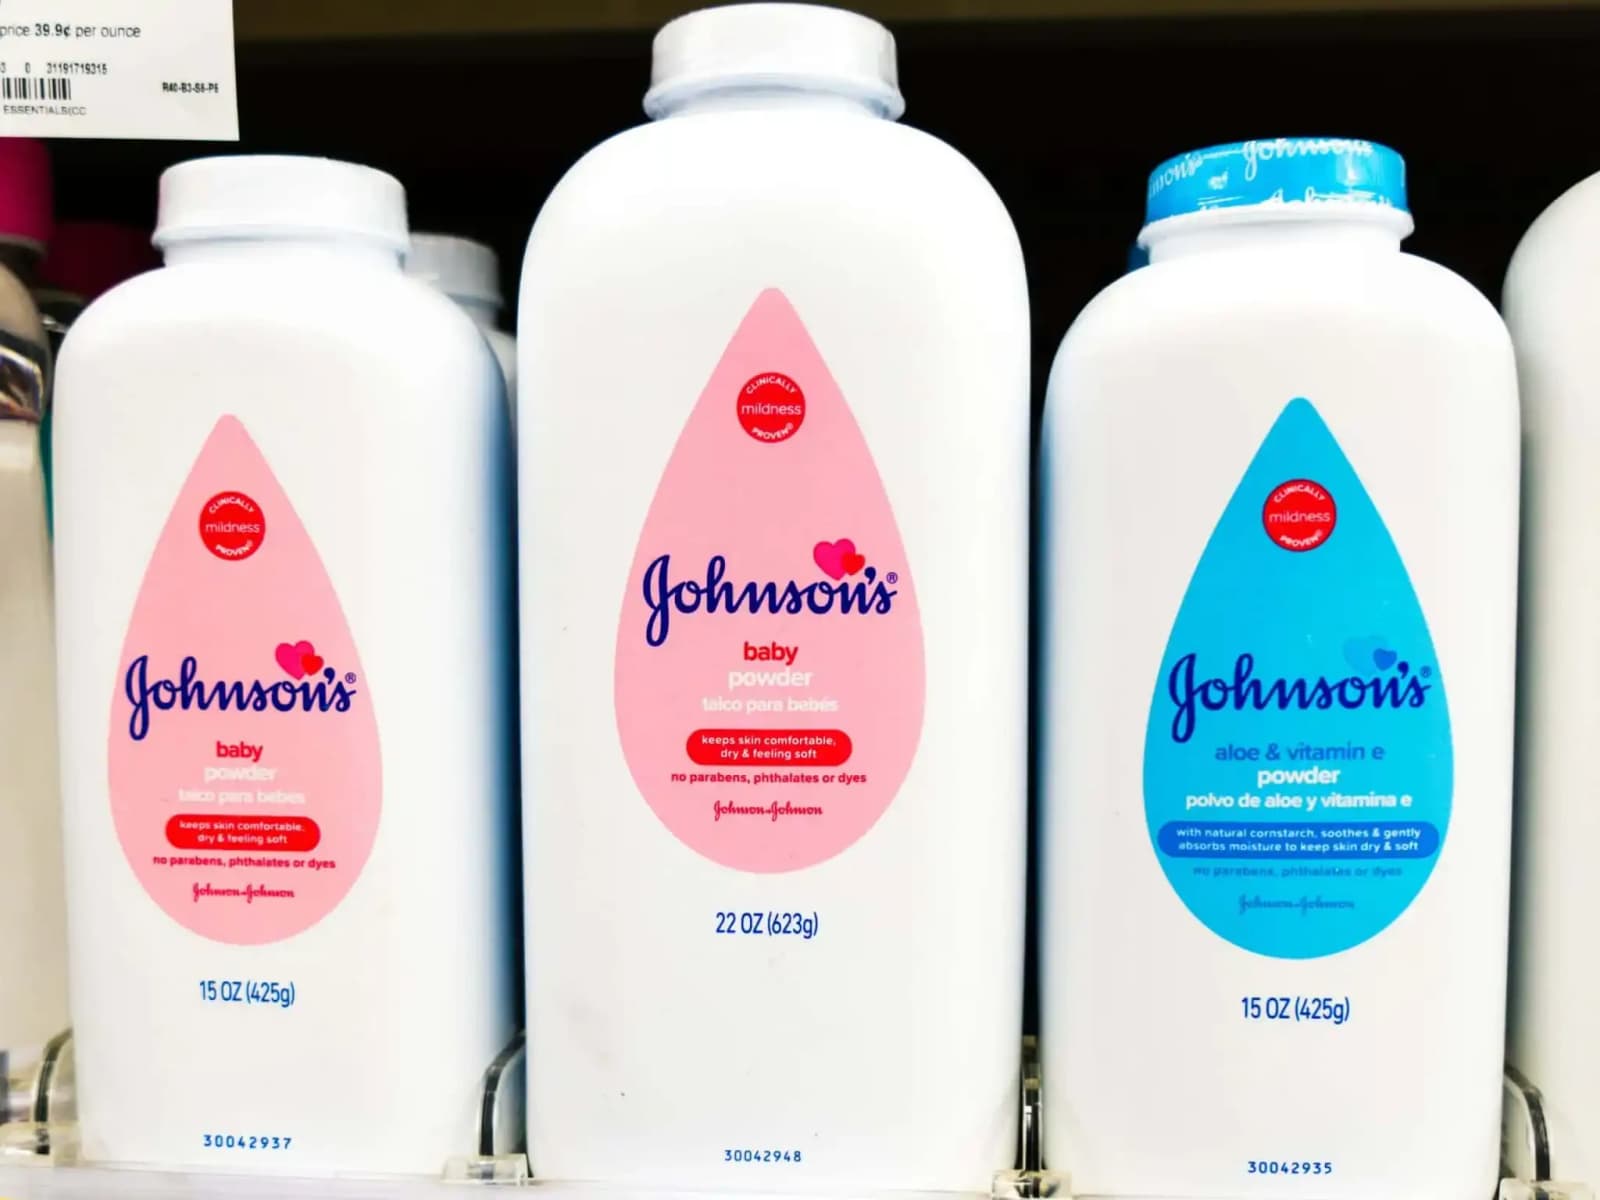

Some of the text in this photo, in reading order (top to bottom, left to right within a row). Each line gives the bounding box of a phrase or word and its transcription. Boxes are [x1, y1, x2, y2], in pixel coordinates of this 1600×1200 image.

[35, 23, 71, 38] 39.9¢
[75, 26, 97, 38] per
[101, 26, 142, 38] ounce
[745, 376, 797, 395] CLINICALLY
[741, 403, 801, 415] mildness
[1269, 511, 1331, 523] mildness
[205, 520, 261, 534] mildness
[744, 641, 799, 666] baby
[729, 667, 814, 690] powder
[746, 700, 783, 715] para
[702, 735, 836, 747] keeps skin comfortable,
[216, 741, 264, 763] baby
[720, 748, 817, 761] dry & feeling soft
[1215, 741, 1385, 761] aloe & vitamin e
[203, 765, 277, 784] powder
[671, 772, 867, 785] no parabens, phthalates or dyes
[1257, 765, 1340, 788] powder
[1186, 792, 1412, 811] polvo de aloe y vitamina e
[213, 821, 235, 831] skin
[1176, 827, 1421, 840] with natural cornstarch, soothes & gently
[266, 834, 288, 845] soft
[1179, 841, 1419, 854] absorbs moisture to keep skin dry & soft
[153, 856, 167, 865] no
[229, 857, 290, 869] phthalates
[293, 860, 305, 869] or
[308, 858, 336, 871] dyes
[716, 911, 819, 940] 22 OZ (623g)
[200, 980, 296, 1008] 15 OZ (425g)
[1242, 996, 1350, 1025] 15 OZ (425g)
[203, 1134, 292, 1150] 30042937
[724, 1149, 802, 1163] 30042948
[1247, 1160, 1333, 1175] 30042935
